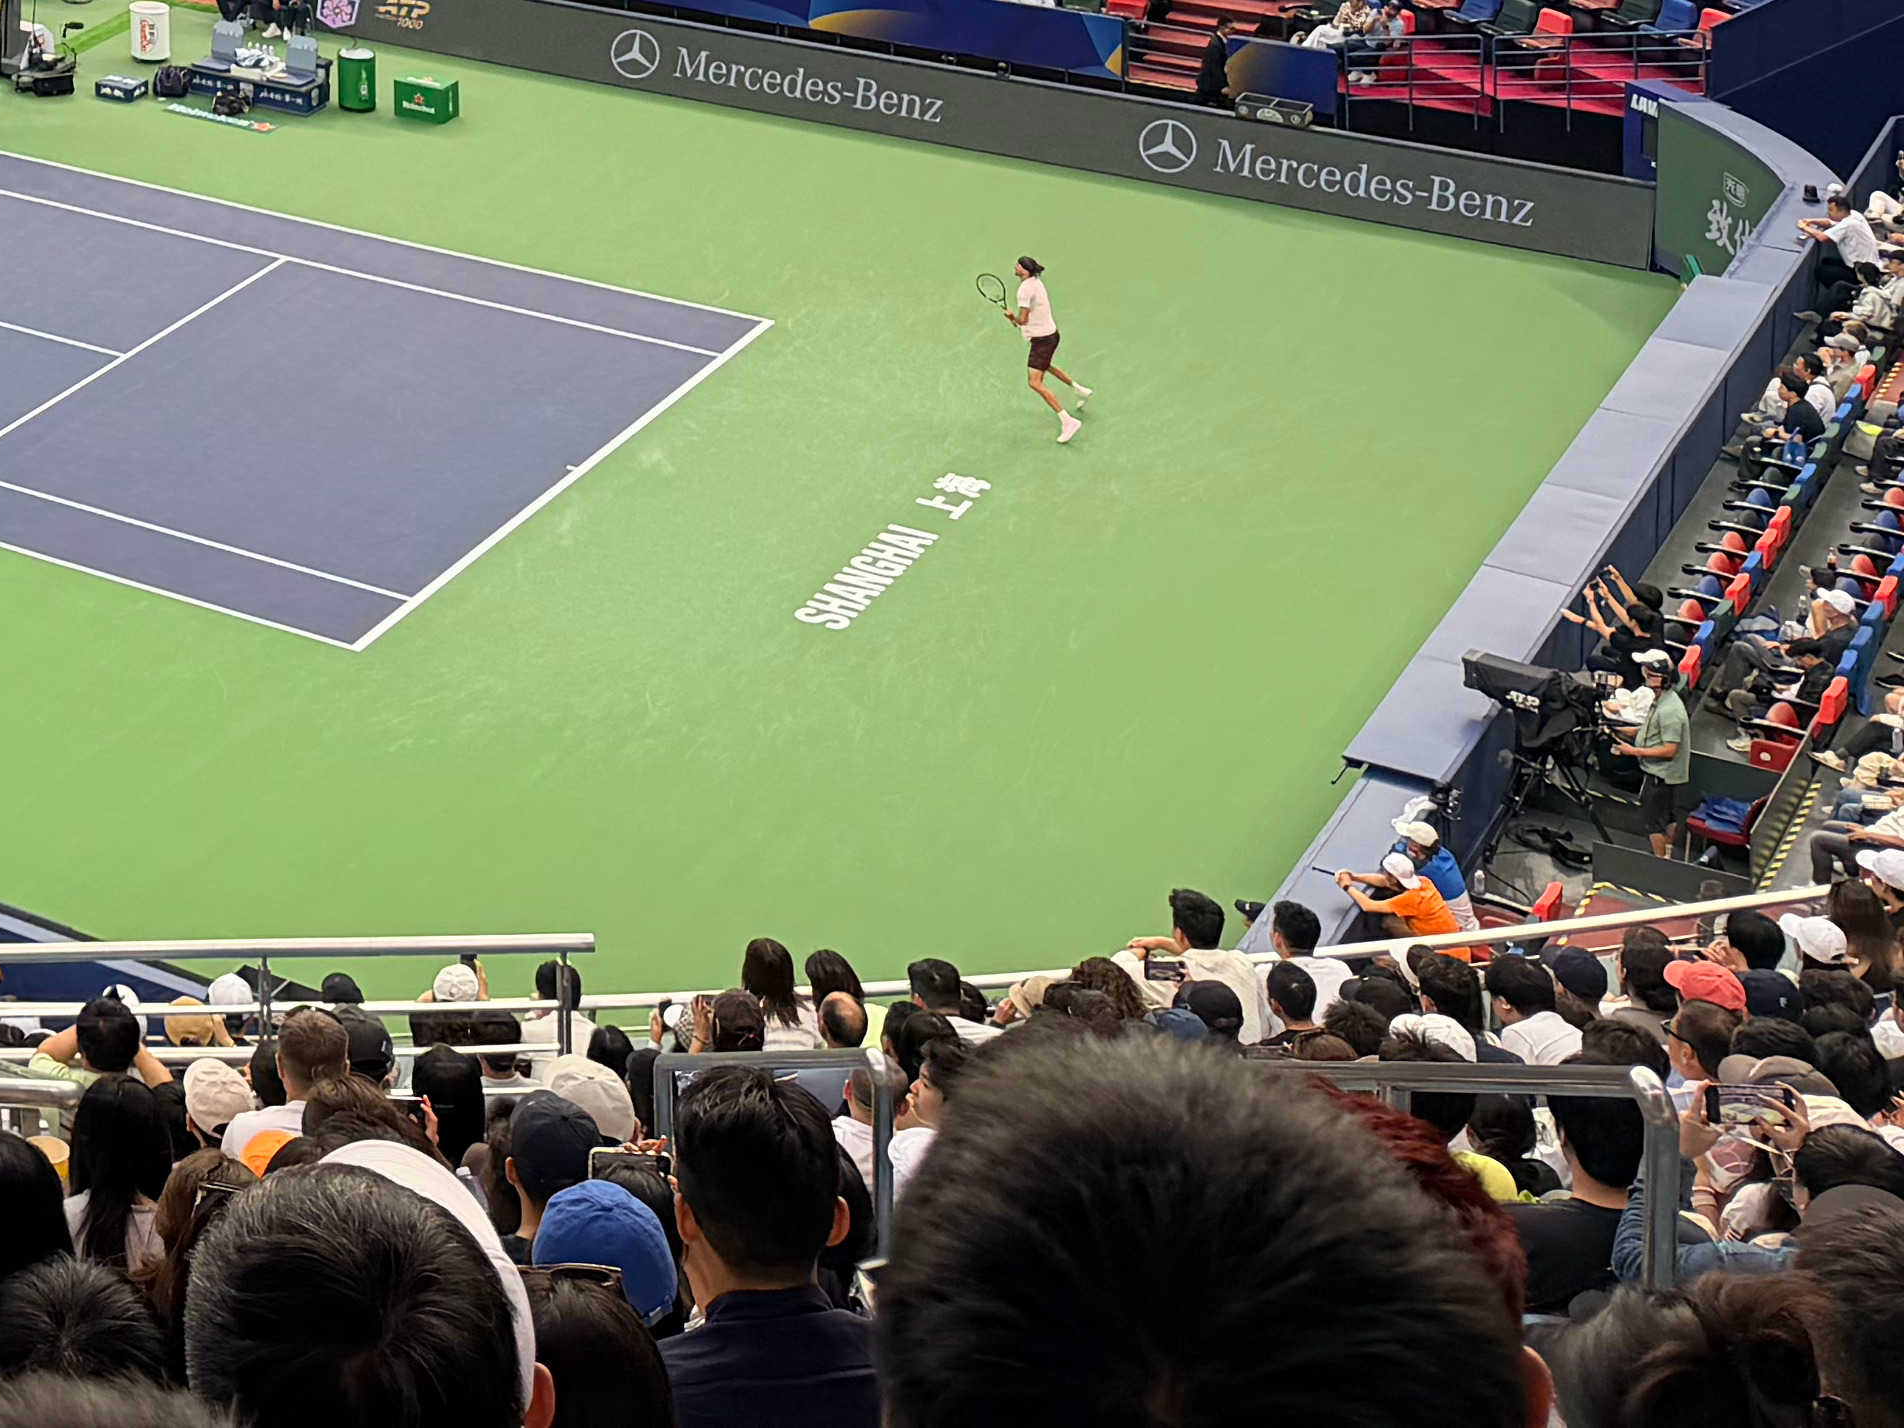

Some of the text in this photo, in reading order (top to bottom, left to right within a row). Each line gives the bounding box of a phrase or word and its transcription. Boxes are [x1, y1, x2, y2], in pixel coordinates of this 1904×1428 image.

[672, 46, 944, 124] Mercedes-Benz
[1213, 138, 1535, 228] Mercedes-Benz
[794, 523, 939, 630] SHANGHAI
